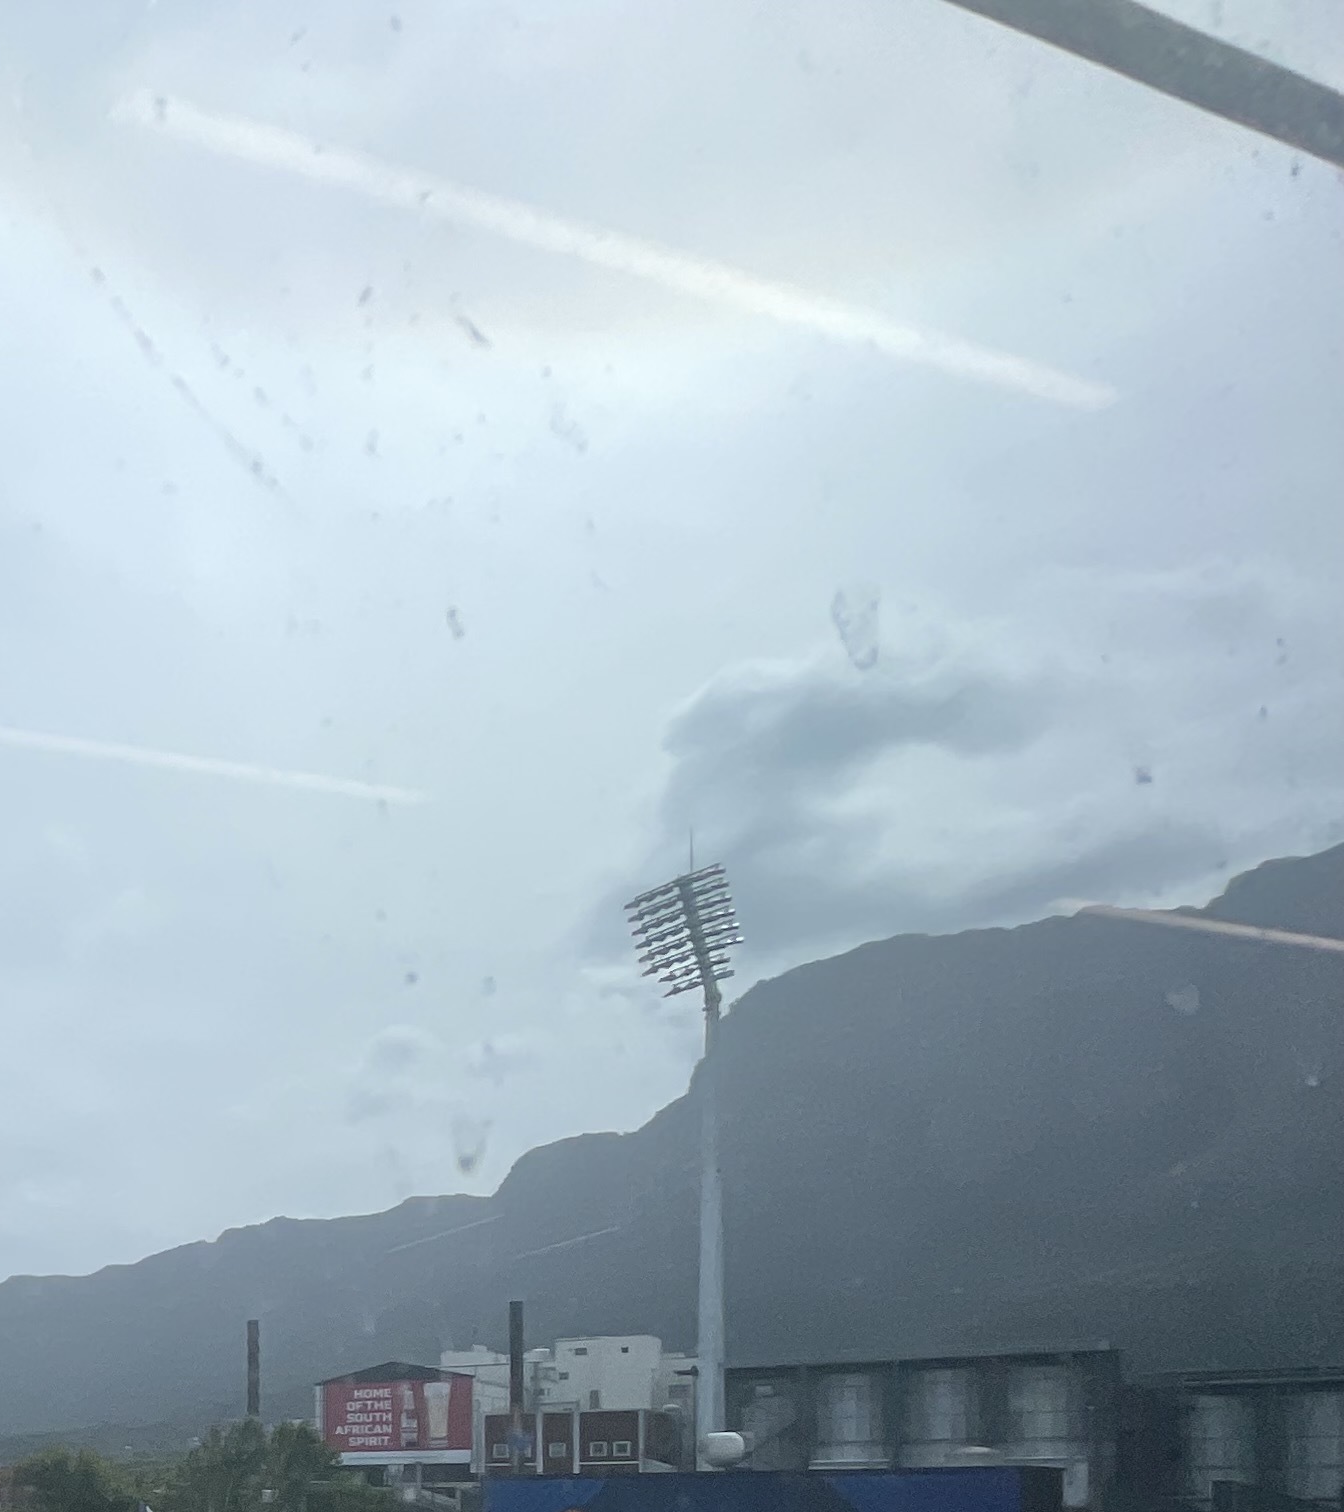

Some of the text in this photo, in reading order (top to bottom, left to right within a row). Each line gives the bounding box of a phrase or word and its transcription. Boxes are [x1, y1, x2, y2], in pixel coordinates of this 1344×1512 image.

[354, 1389, 392, 1398] HOME
[346, 1400, 392, 1411] OF THE
[346, 1412, 392, 1423] SOUTH
[335, 1424, 392, 1435] AFRICAN
